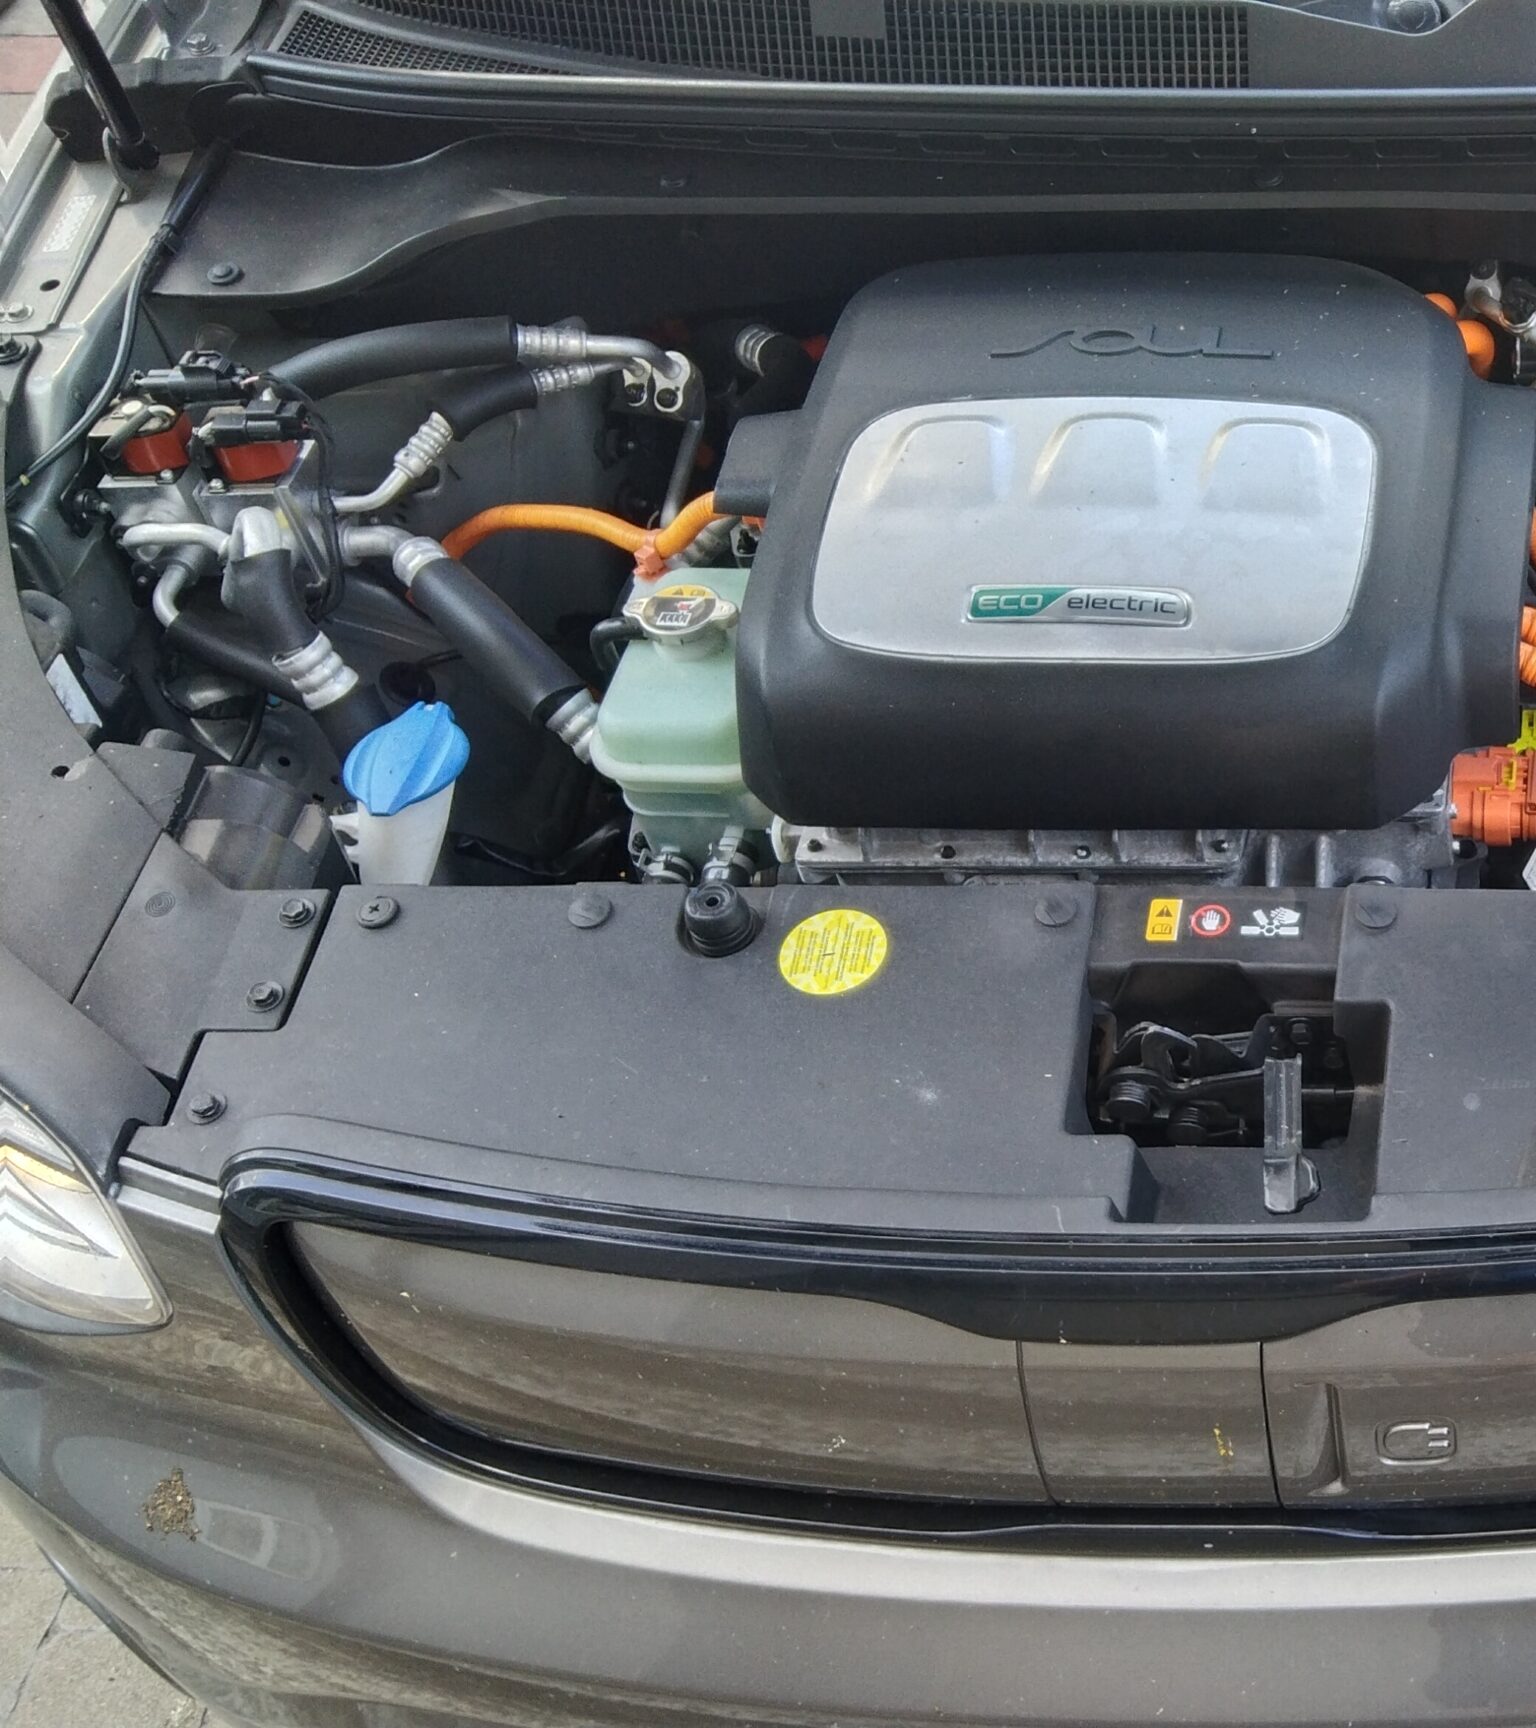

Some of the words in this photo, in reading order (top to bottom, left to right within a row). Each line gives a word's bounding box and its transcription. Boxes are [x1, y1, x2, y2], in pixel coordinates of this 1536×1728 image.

[989, 324, 1274, 360] SOUL
[978, 594, 1043, 610] ECO
[1067, 594, 1176, 614] electric
